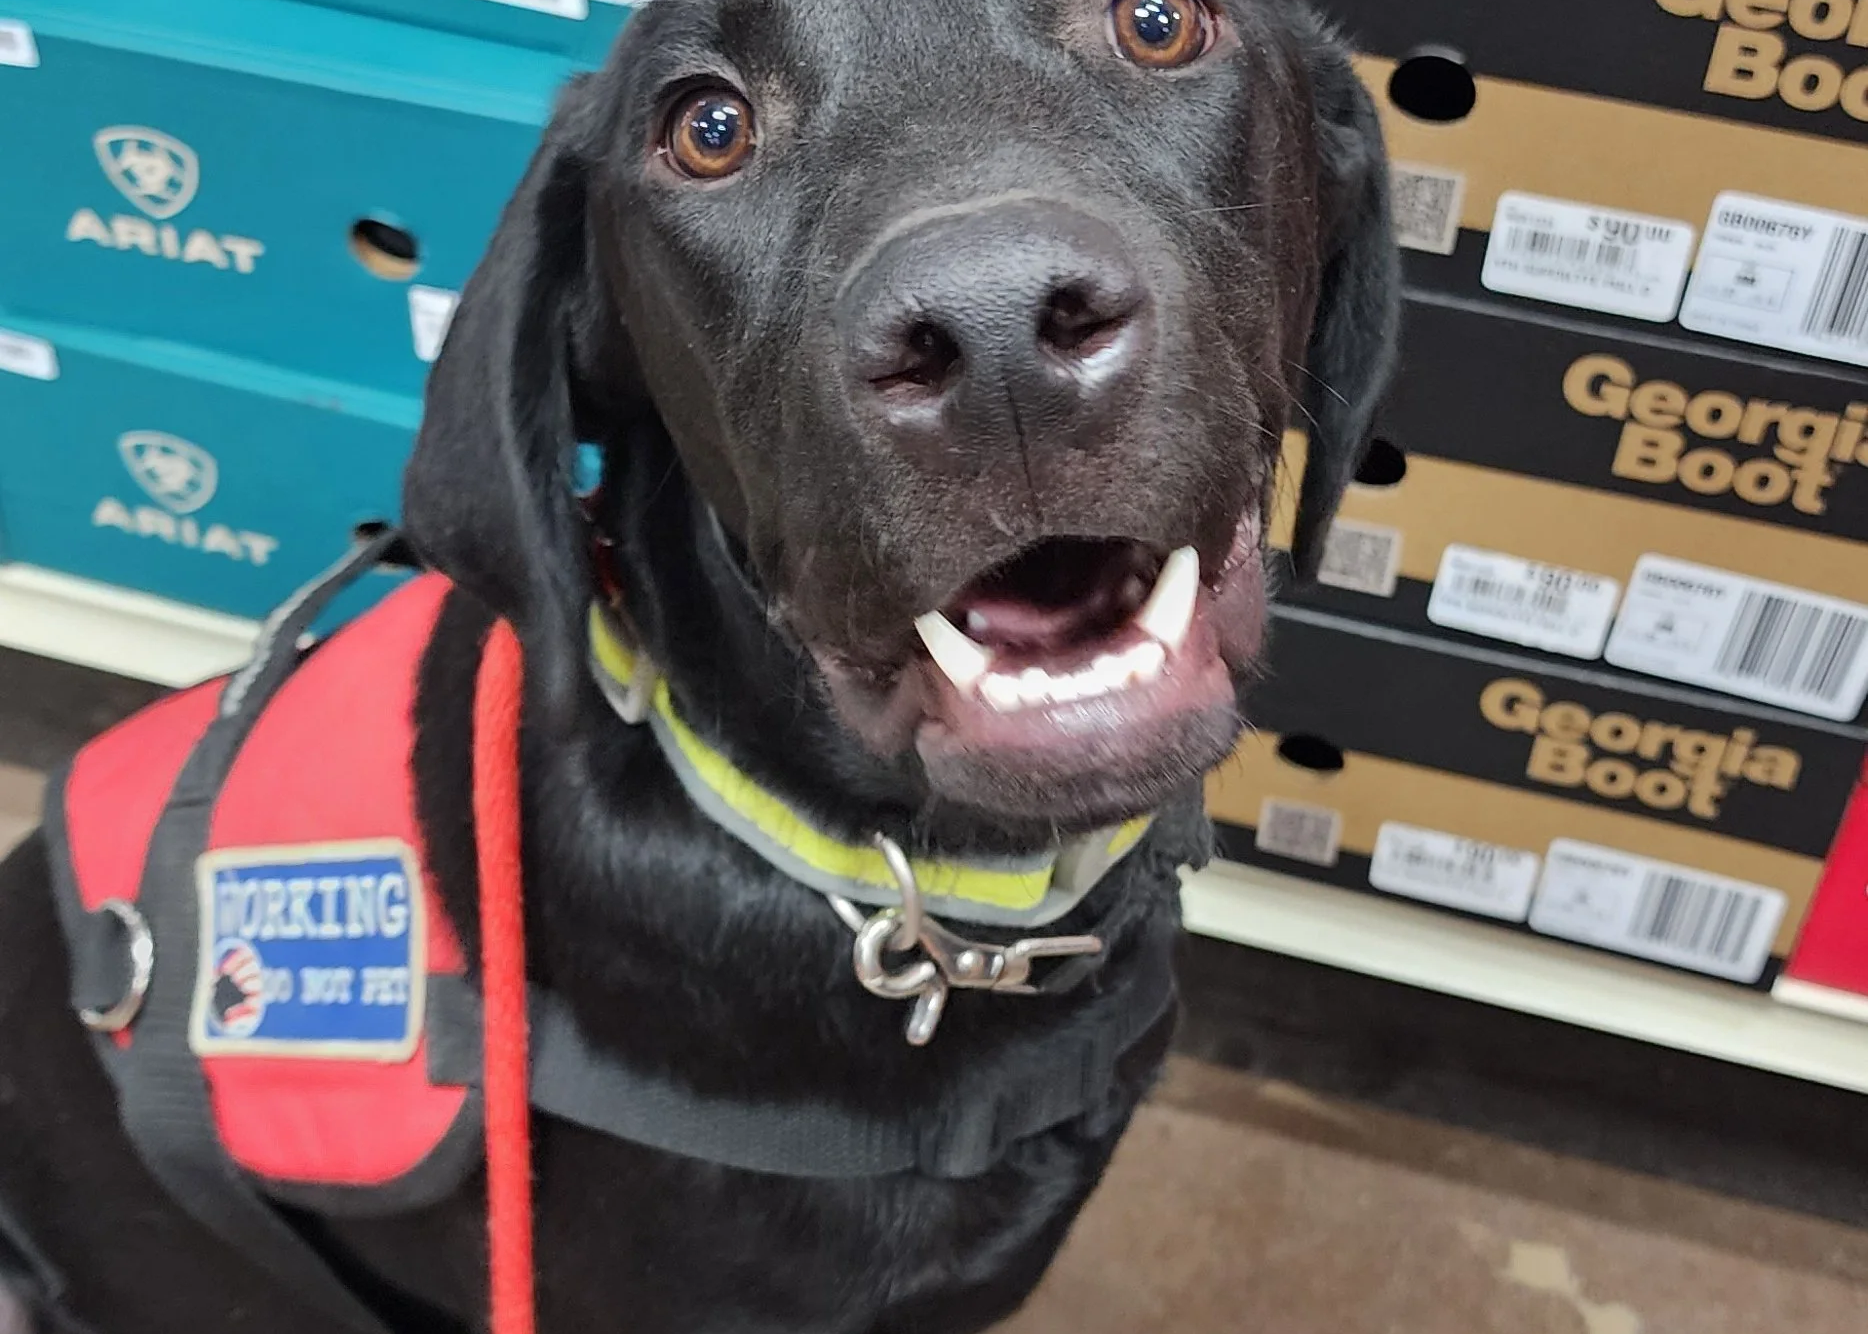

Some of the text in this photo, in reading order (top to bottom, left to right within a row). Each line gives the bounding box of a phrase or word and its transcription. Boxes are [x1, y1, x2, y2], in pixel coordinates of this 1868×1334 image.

[66, 208, 265, 273] ARIAT
[1611, 419, 1834, 516] Boot
[92, 496, 279, 567] ARIAT
[1480, 677, 1801, 792] Georgia
[1526, 733, 1727, 820] Boot
[299, 966, 355, 1005] NOT
